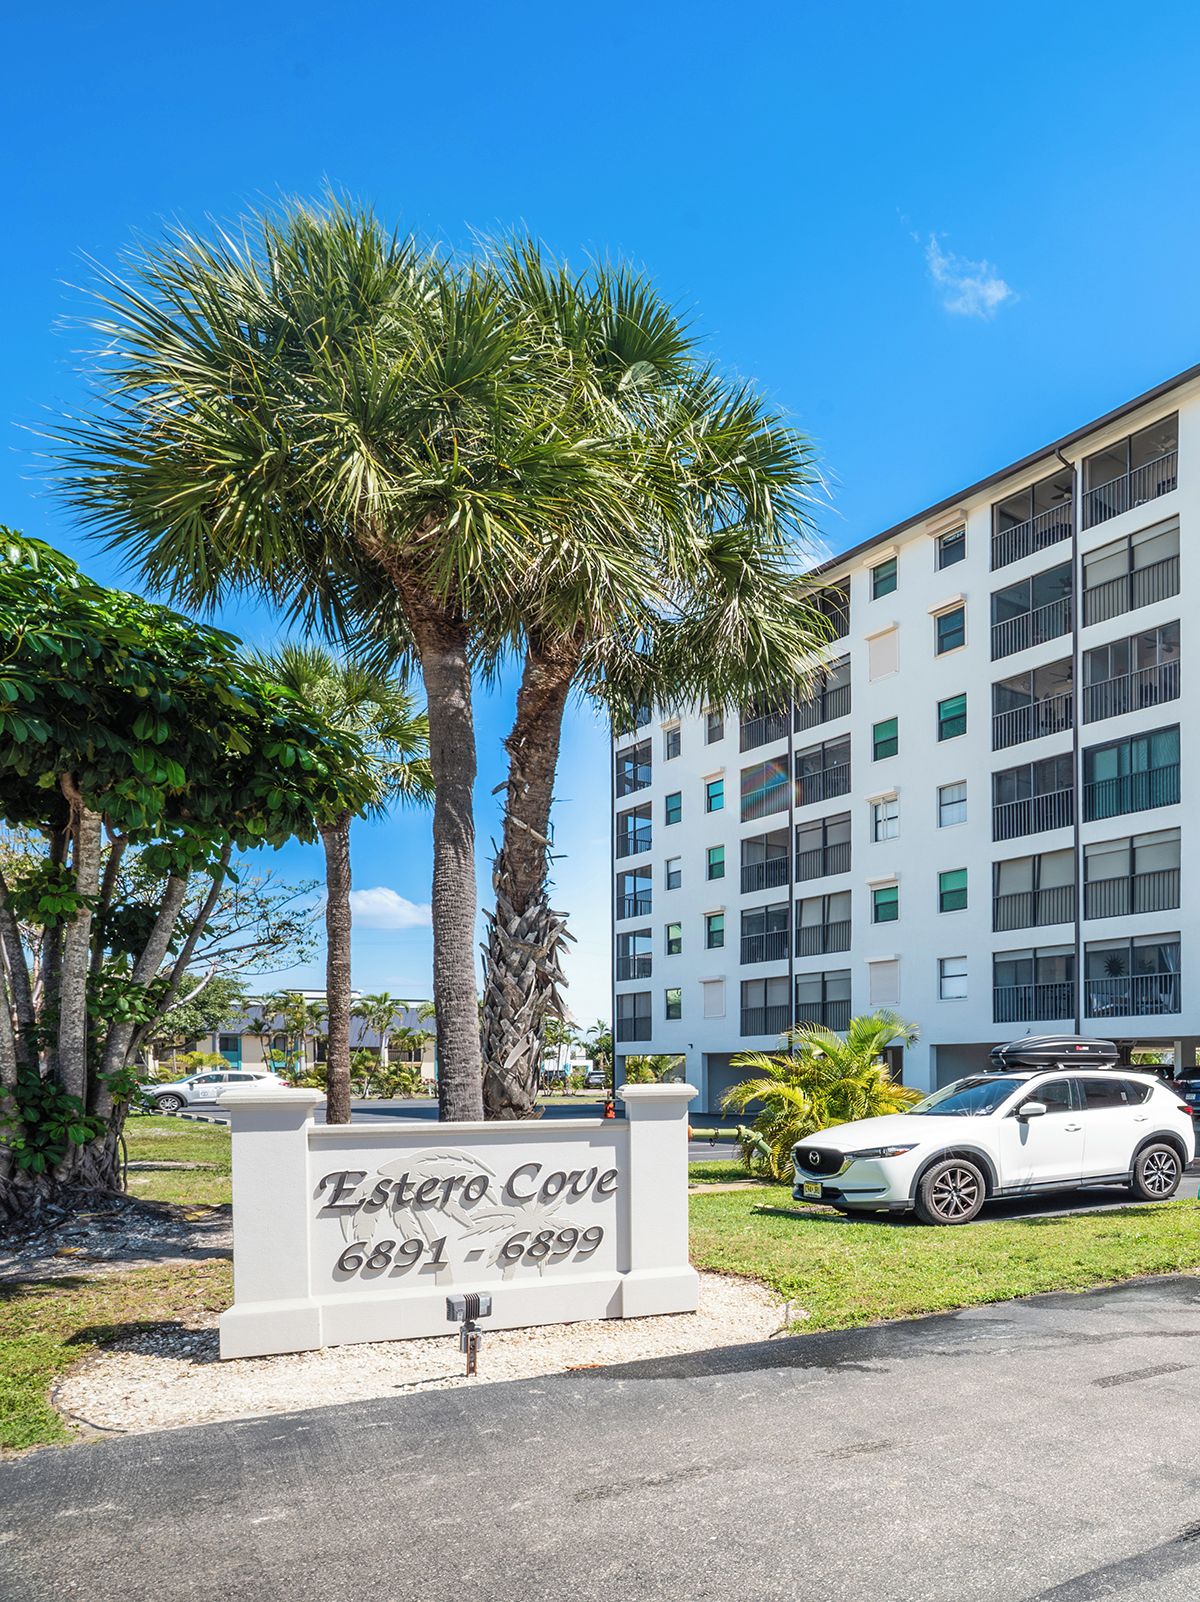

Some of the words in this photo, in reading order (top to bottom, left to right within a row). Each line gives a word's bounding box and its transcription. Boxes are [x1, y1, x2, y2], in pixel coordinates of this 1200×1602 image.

[319, 1170, 490, 1210] Estero
[506, 1162, 619, 1200] Cove
[337, 1235, 449, 1273] 6891
[501, 1225, 605, 1260] 6899
